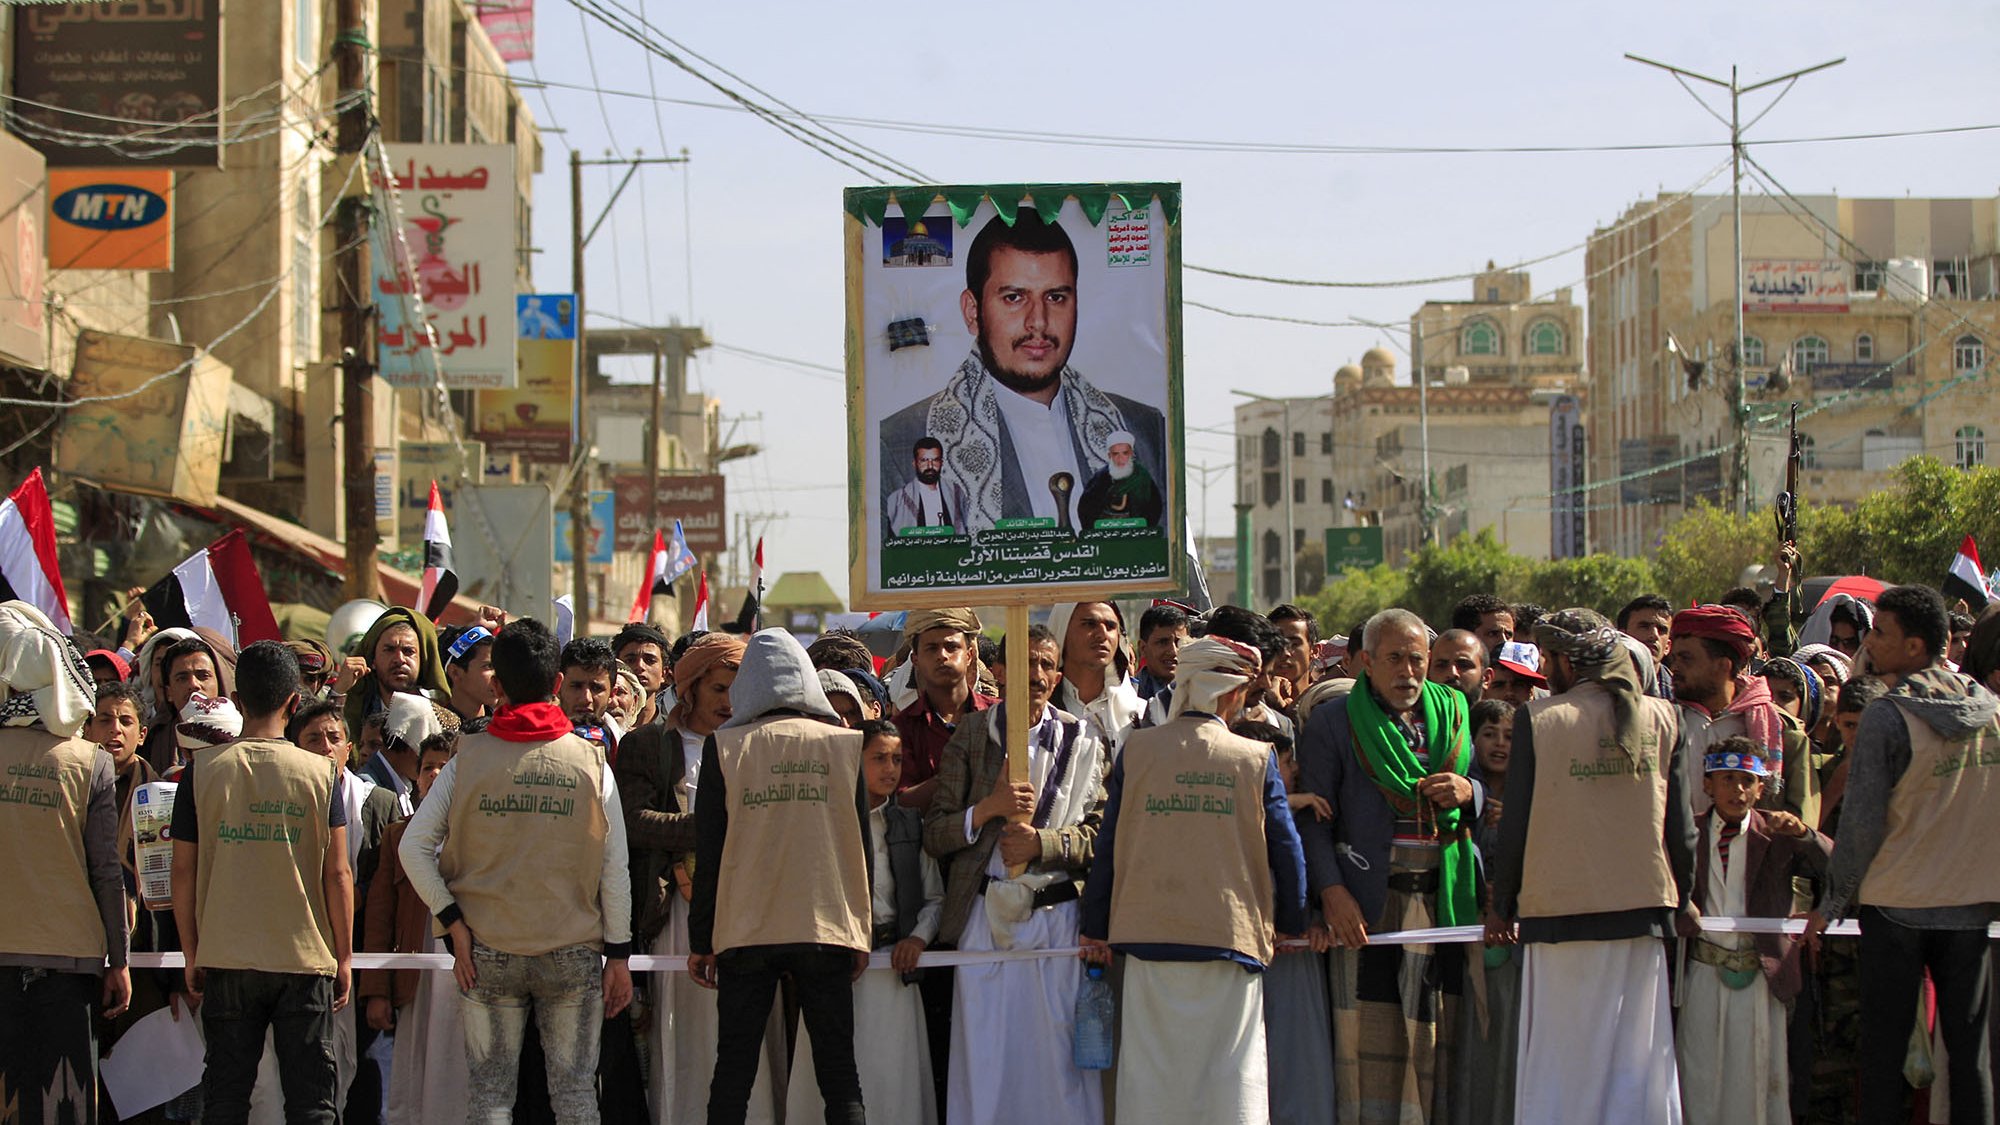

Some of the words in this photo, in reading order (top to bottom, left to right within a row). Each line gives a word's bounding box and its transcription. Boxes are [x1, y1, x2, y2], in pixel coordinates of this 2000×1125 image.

[371, 159, 490, 199] صيدلية
[72, 193, 148, 220] MTN
[1133, 210, 1149, 220] الله
[1747, 275, 1813, 303] الجلدية
[378, 314, 487, 356] المركزية
[979, 531, 1006, 542] الحوثي
[958, 545, 999, 566] الأولى
[1001, 546, 1051, 563] قضيتنا
[1052, 544, 1100, 562] القدس
[887, 570, 936, 587] وأعوانهم
[936, 569, 987, 584] الصهاينة
[986, 569, 1003, 583] من
[1003, 567, 1042, 583] القدس
[1042, 565, 1081, 581] لتحرير
[1083, 563, 1103, 577] الله
[1103, 565, 1129, 579] بعون
[1130, 562, 1166, 577] ماضون
[8, 763, 47, 780] الفعاليات
[770, 759, 810, 778] الفعاليات
[811, 759, 830, 779] لجنة
[1569, 757, 1625, 781] التنظيمية
[513, 771, 555, 789] الفعاليات
[556, 774, 577, 792] لجنة
[1175, 771, 1215, 789] الفعاليات
[1215, 771, 1236, 791] لجنة
[29, 787, 63, 812] اللجنة
[743, 782, 795, 810] التنظيمية
[797, 782, 828, 807] اللجنة
[249, 801, 286, 817] الفعاليات
[286, 801, 307, 820] لجنة
[479, 794, 537, 817] التنظيمية
[539, 795, 574, 820] اللجنة
[1145, 793, 1200, 816] التنظيمية
[1202, 794, 1235, 819] اللجنة
[218, 820, 271, 844] التنظيمية
